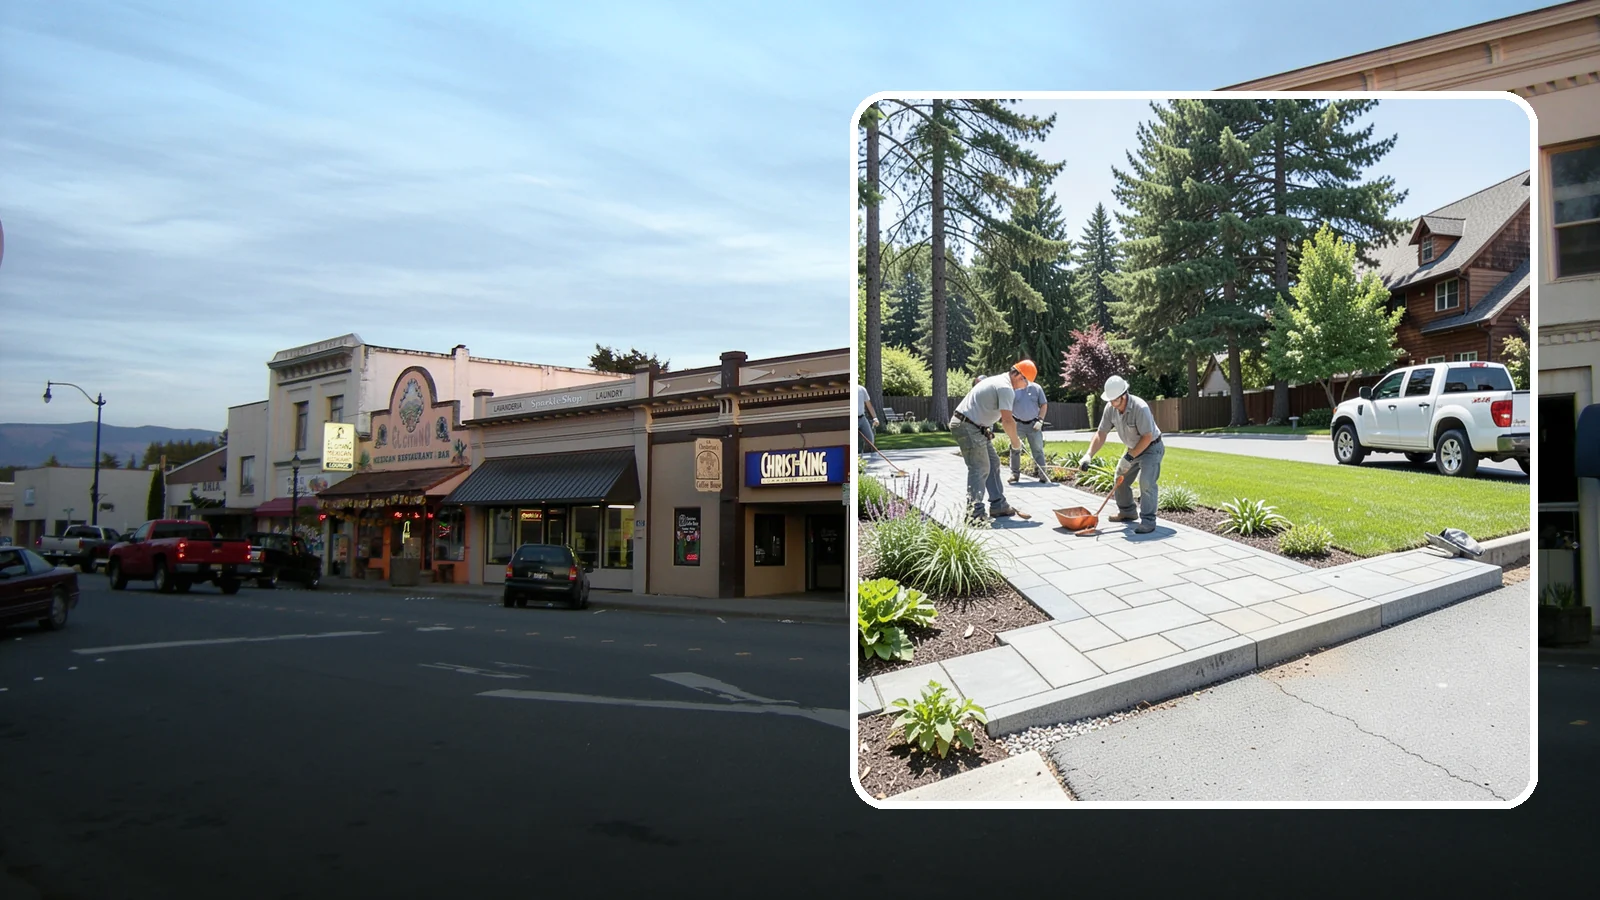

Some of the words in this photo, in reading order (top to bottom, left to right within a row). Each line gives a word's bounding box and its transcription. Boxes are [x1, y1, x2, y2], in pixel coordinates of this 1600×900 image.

[494, 402, 522, 412] LAVANDERIA
[530, 397, 561, 409] Sparkle
[561, 394, 583, 405] Shop
[596, 389, 623, 400] LAUNDRY
[373, 454, 396, 464] MEXICAN
[397, 451, 433, 462] RESTAURANT
[437, 450, 450, 459] BAR
[760, 452, 797, 478] CHRIST
[798, 450, 827, 476] KING
